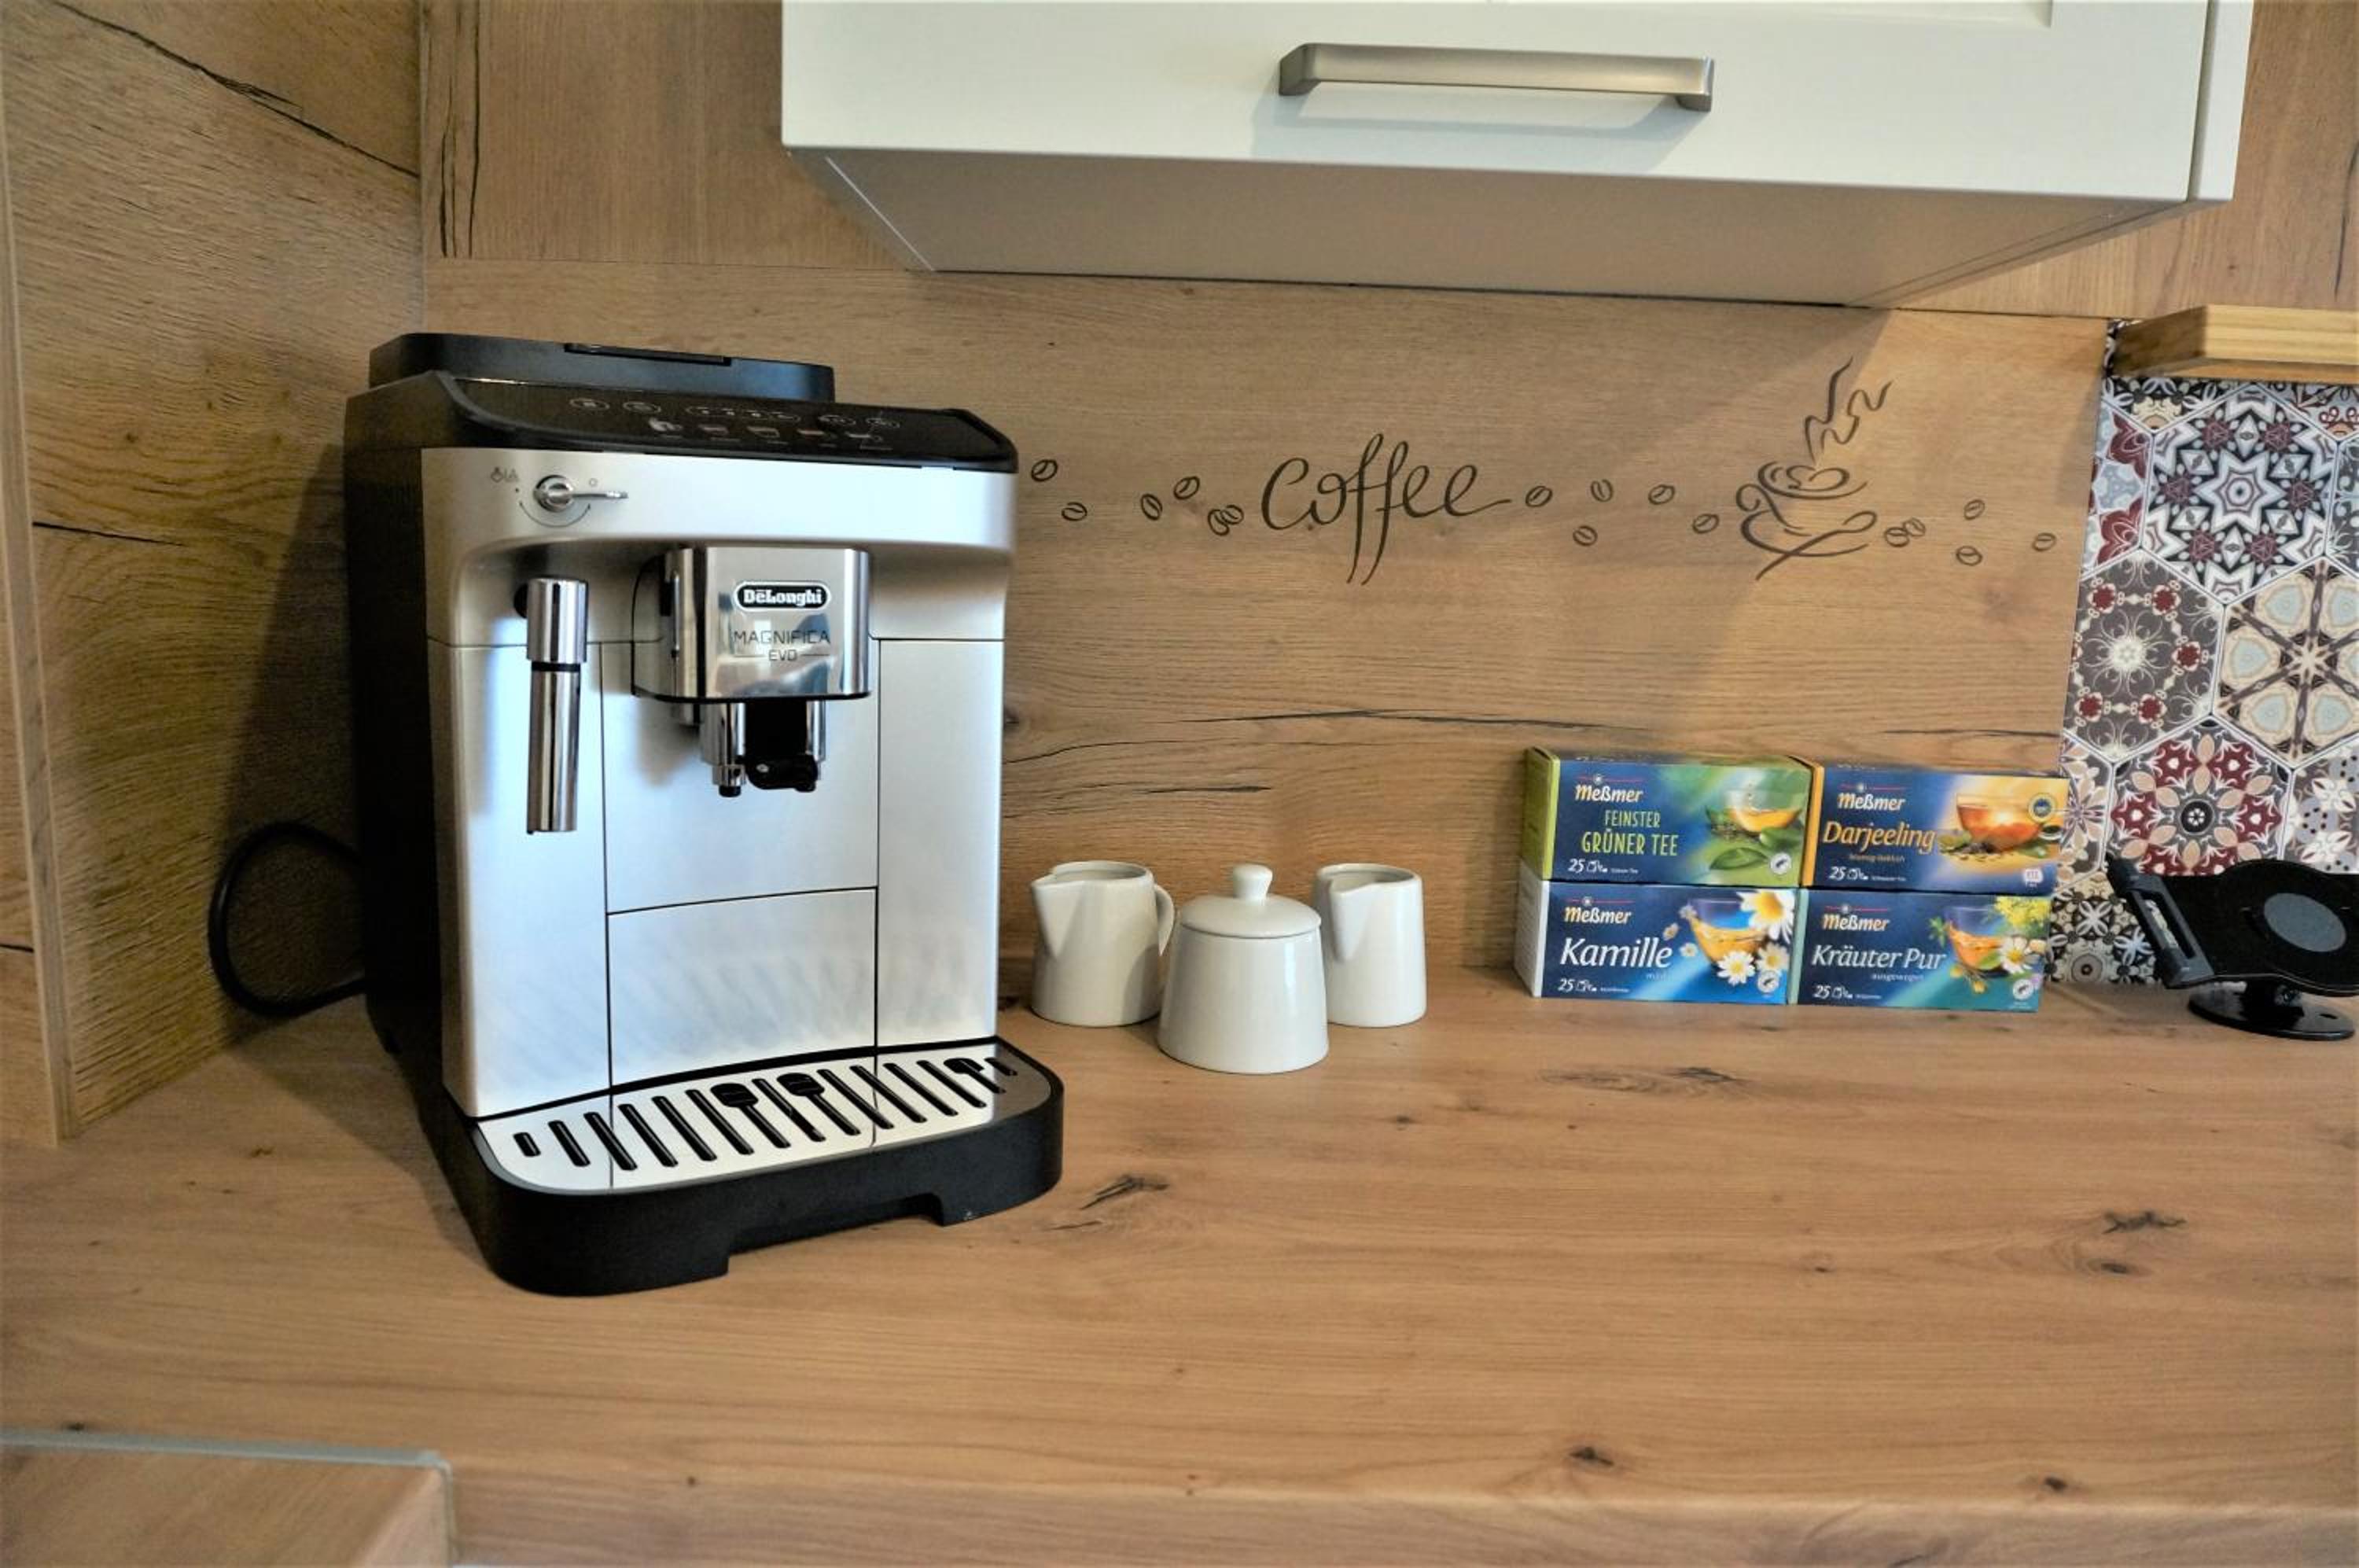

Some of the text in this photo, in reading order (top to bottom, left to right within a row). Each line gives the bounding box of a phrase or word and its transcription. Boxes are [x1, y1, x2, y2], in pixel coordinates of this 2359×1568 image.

[734, 630, 830, 645] MAGNIFICA
[1604, 809, 1661, 828] FEINSTER
[1581, 828, 1680, 856] GRÜNER TEE
[1823, 821, 1938, 855] Darjeeling
[1568, 858, 1585, 874] 25
[1828, 866, 1847, 881] 25
[1559, 937, 1673, 968] Kamille
[1812, 944, 1947, 970] Kräuter Pur
[1558, 977, 1575, 992] 25
[1813, 985, 1831, 999] 25
